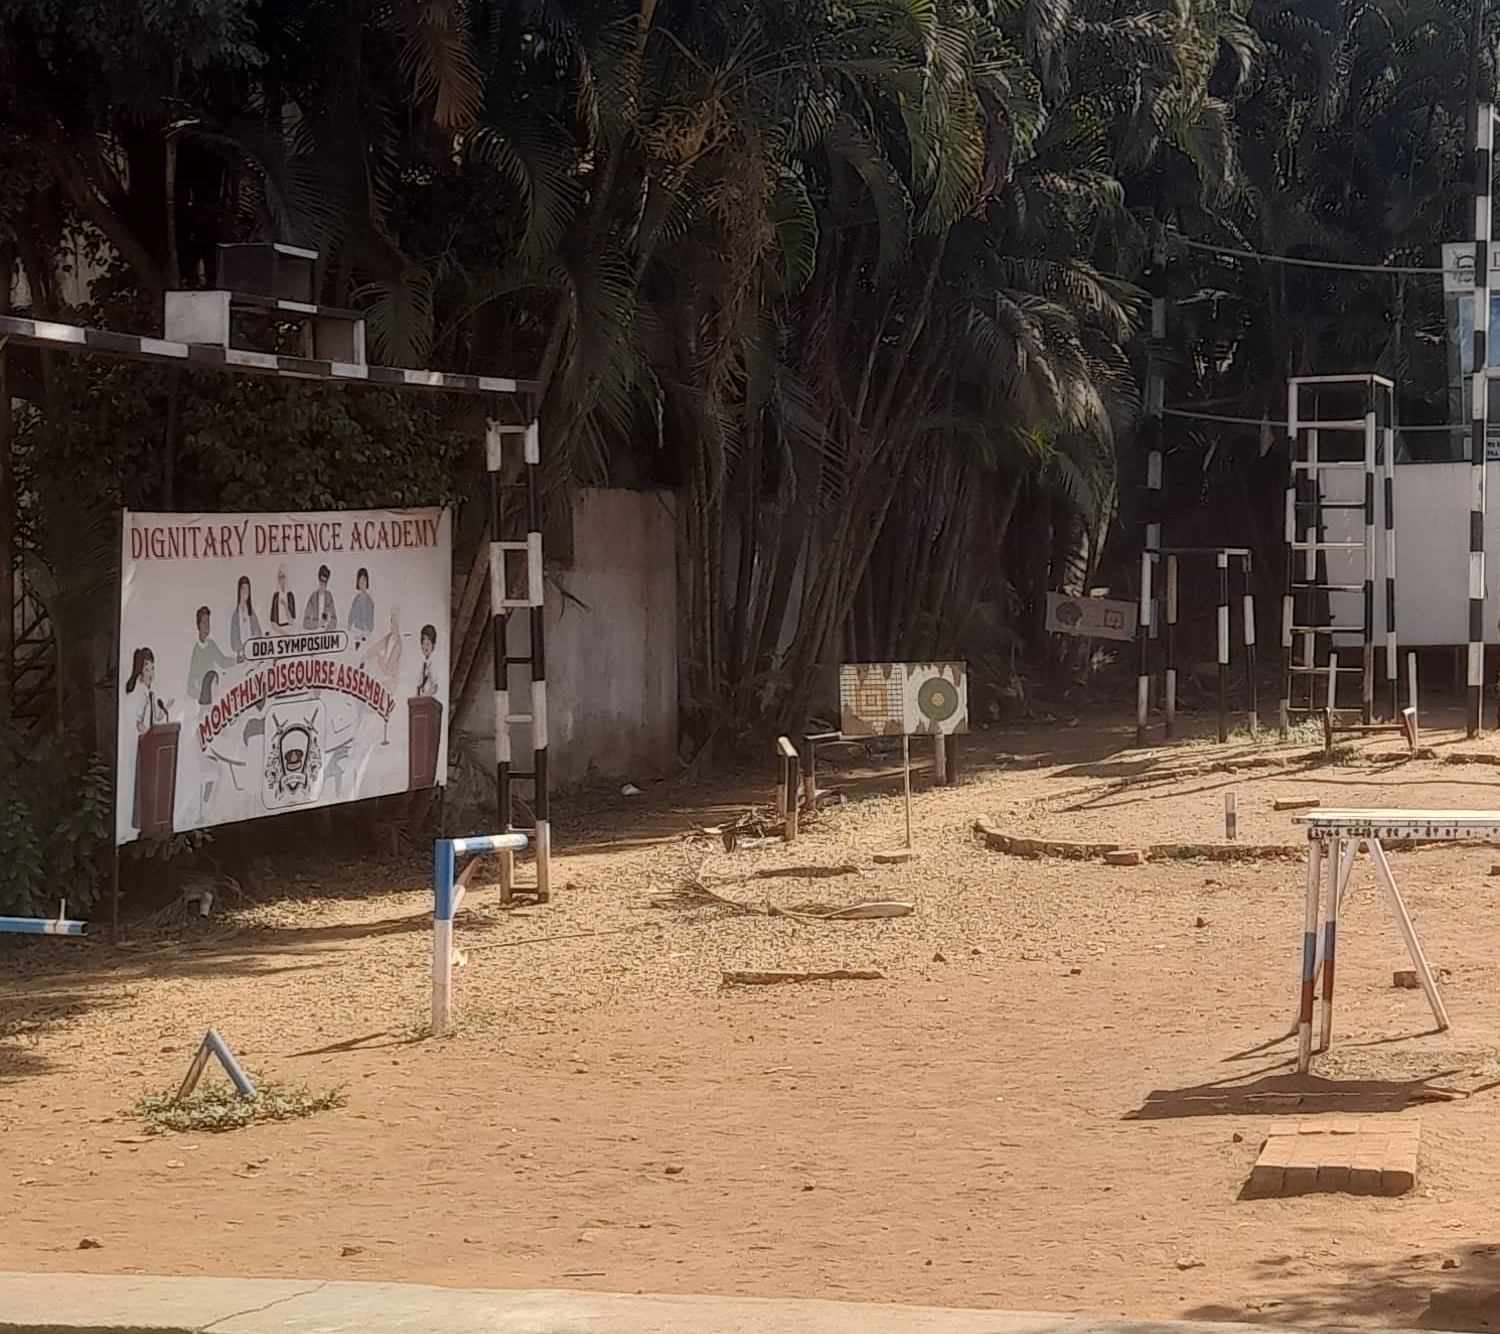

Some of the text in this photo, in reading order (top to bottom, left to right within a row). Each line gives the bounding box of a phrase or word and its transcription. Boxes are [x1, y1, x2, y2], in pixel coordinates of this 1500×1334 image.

[130, 514, 441, 560] DIGNITARY DEFENCE ACADEMY
[252, 635, 340, 657] DDA SYMPOSIUM
[199, 660, 396, 748] MONTHLY DISCOURSE ASSEMBLY
